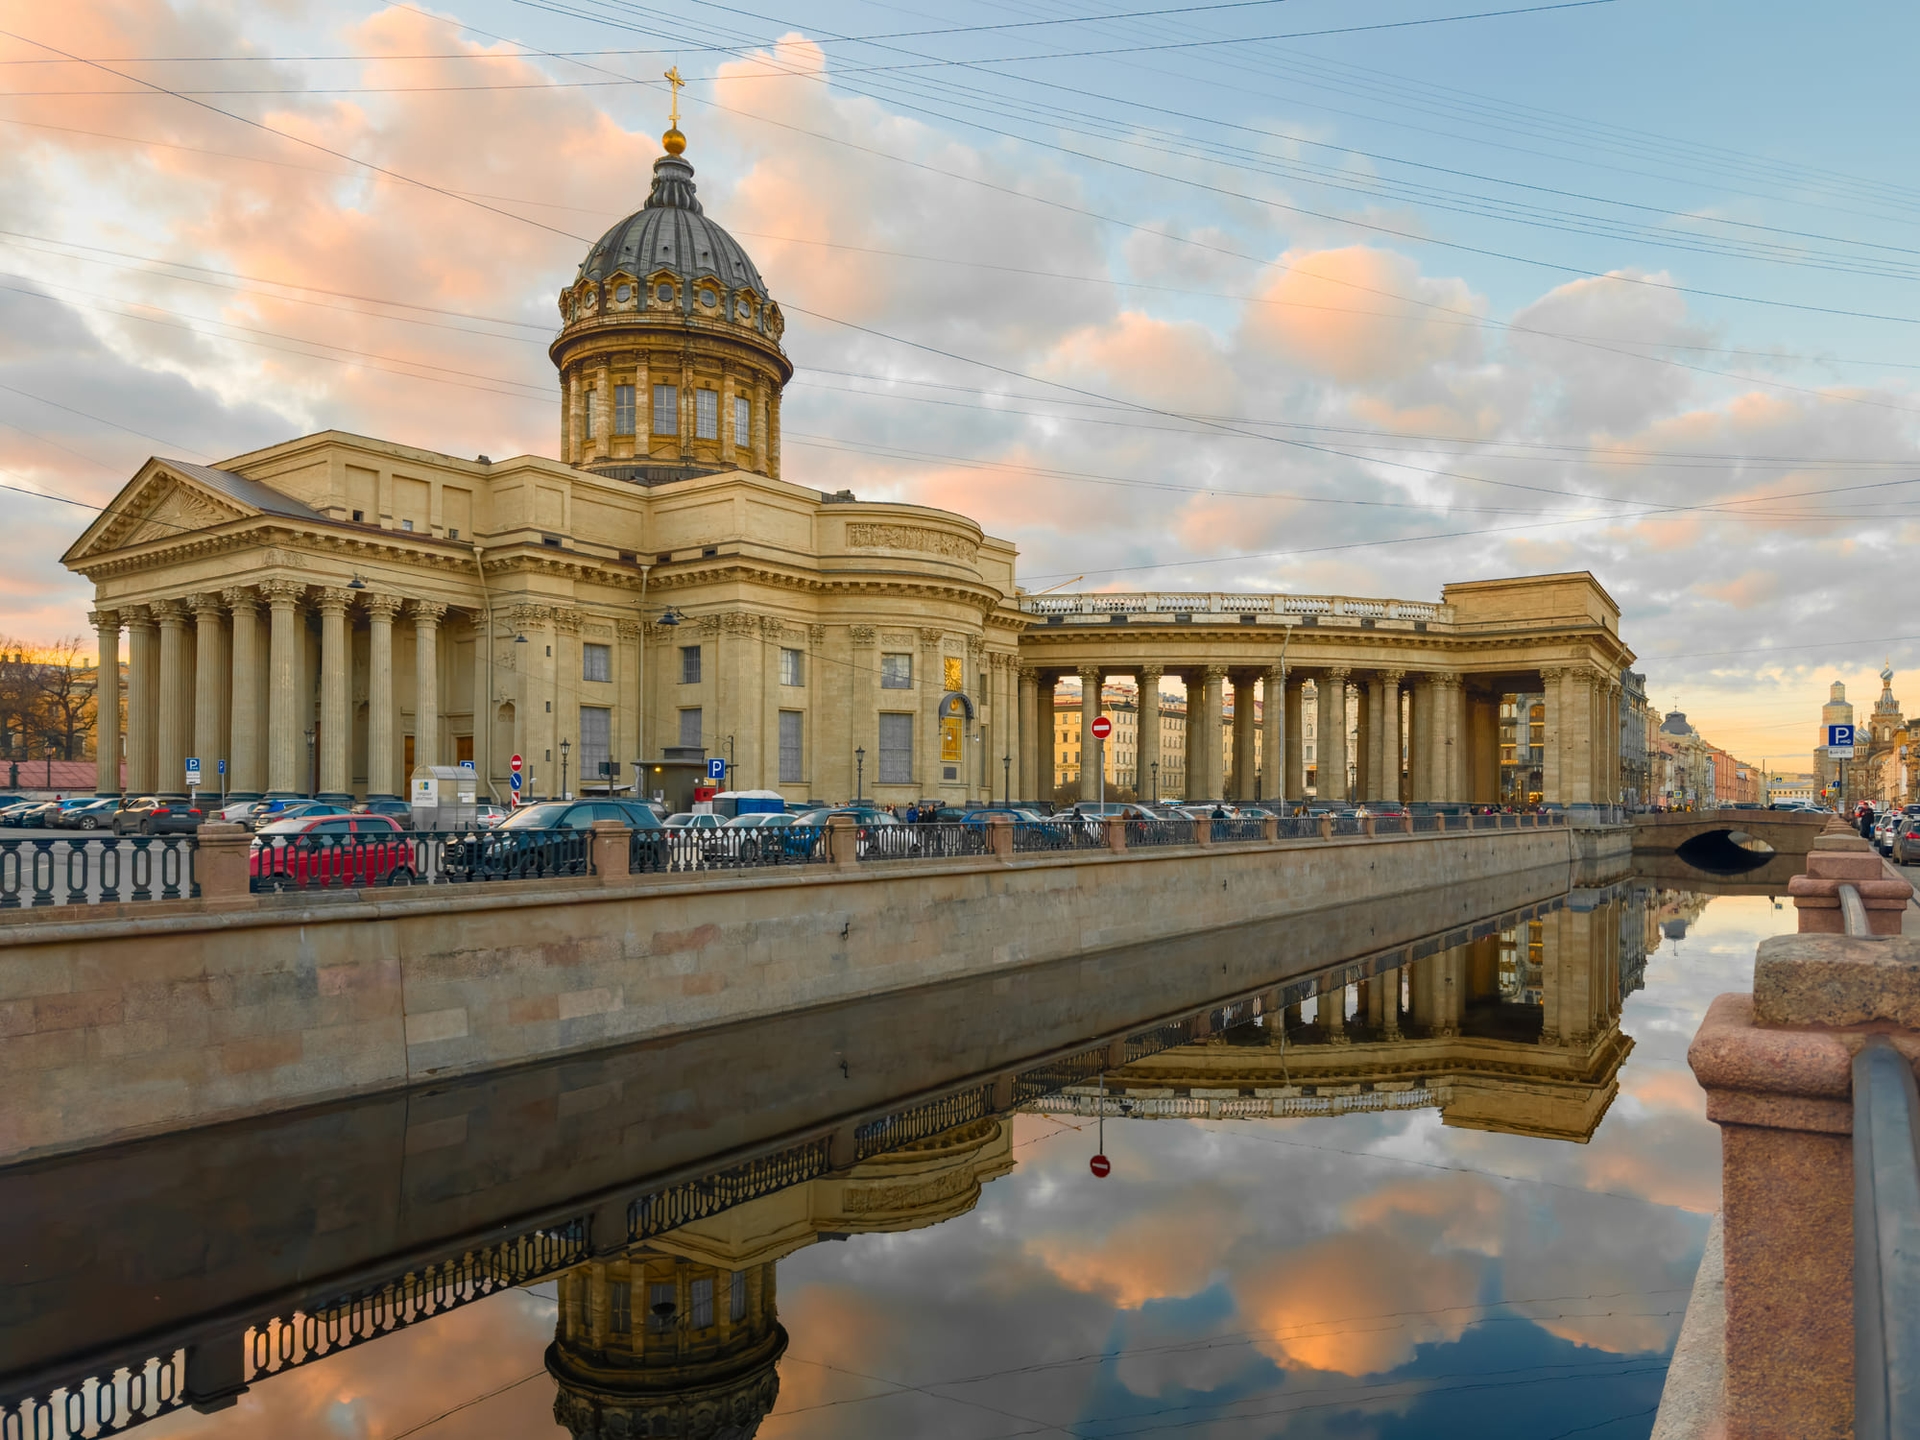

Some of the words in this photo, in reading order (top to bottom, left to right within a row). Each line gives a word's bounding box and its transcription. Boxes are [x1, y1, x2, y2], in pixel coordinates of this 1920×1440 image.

[1835, 727, 1849, 744] P
[189, 759, 198, 770] P
[712, 760, 722, 776] P
